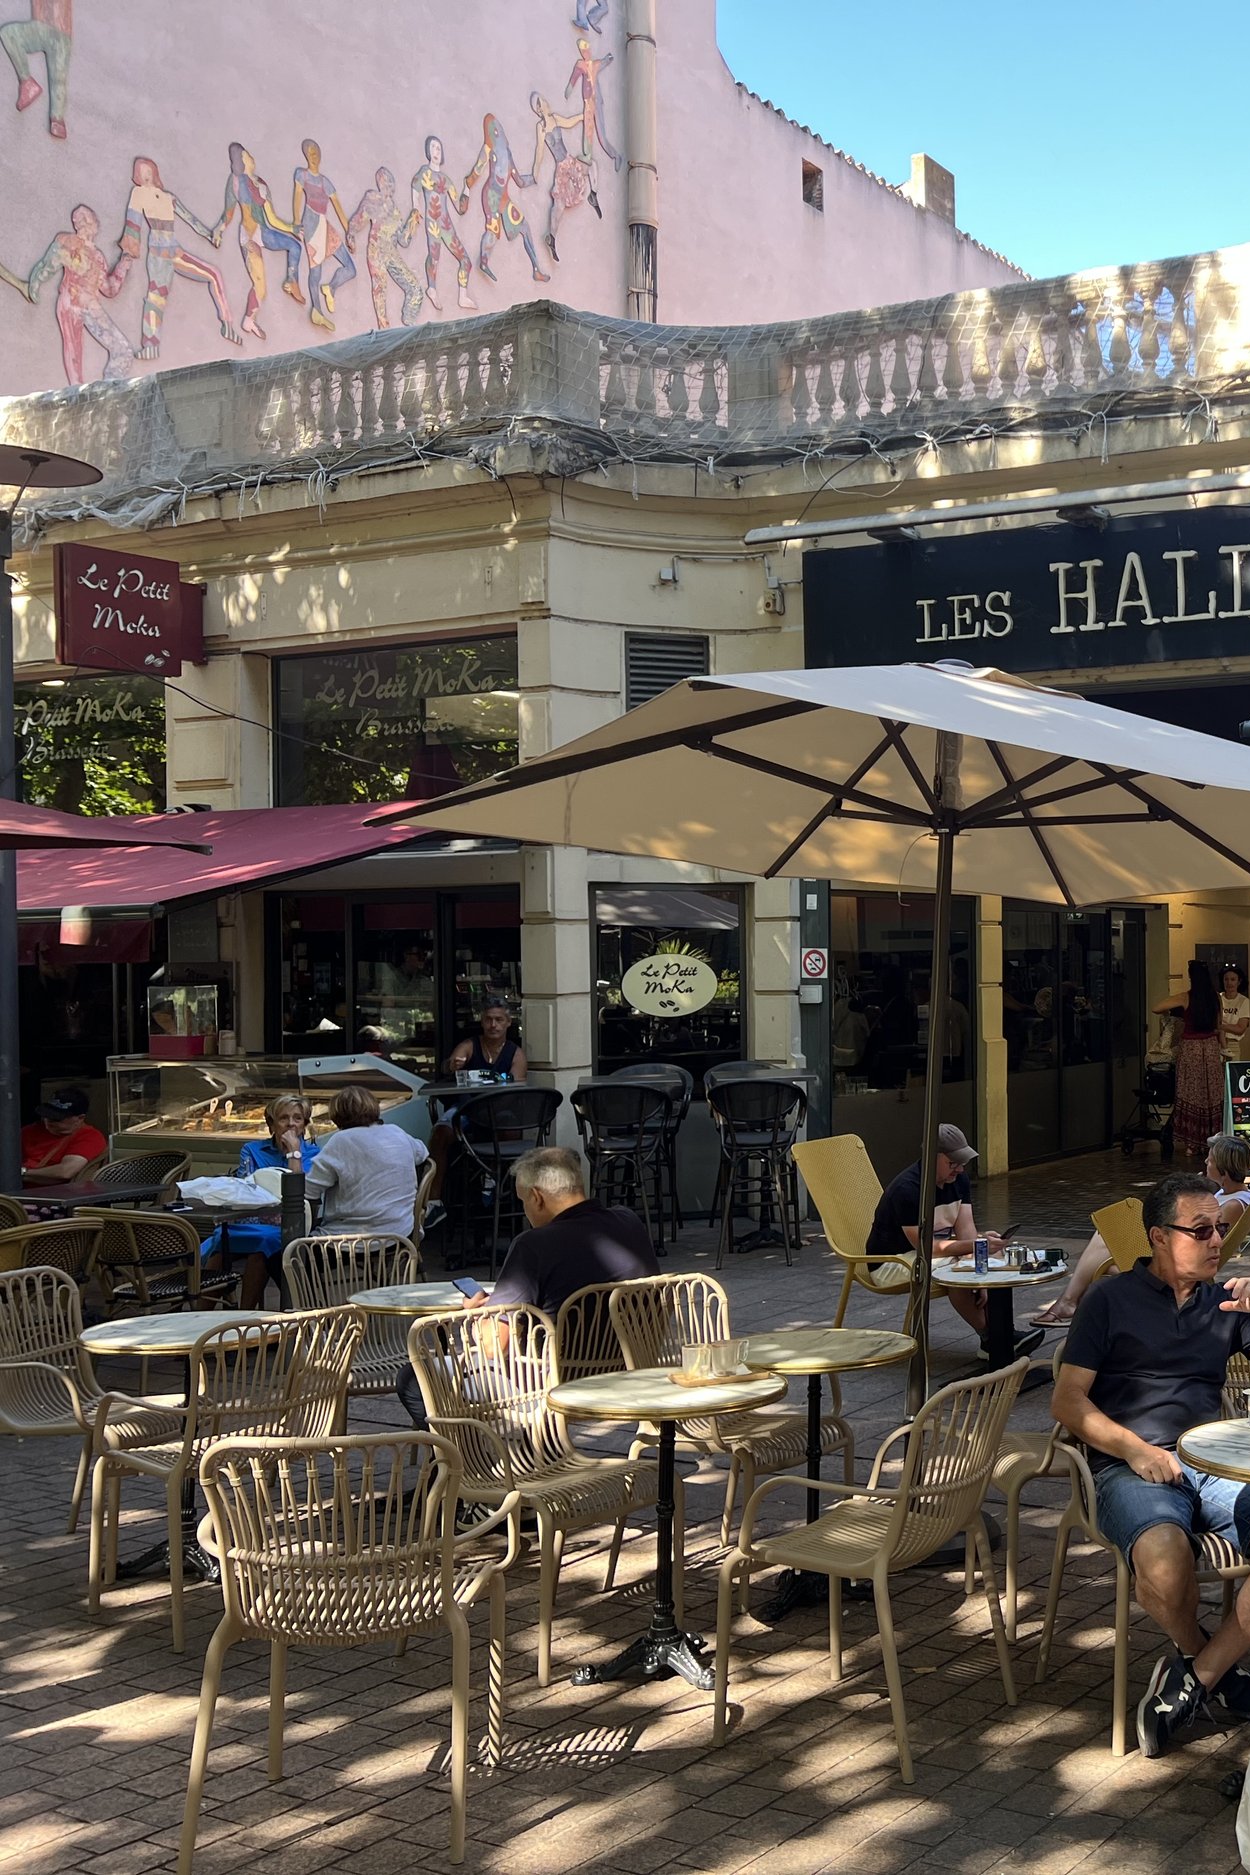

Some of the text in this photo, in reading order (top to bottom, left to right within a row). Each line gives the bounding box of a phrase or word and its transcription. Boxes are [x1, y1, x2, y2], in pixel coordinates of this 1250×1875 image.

[77, 563, 170, 600] Le Petit
[915, 591, 1013, 643] LES
[315, 674, 346, 704] Le
[348, 668, 408, 708] Petit
[641, 962, 698, 980] Le Petit
